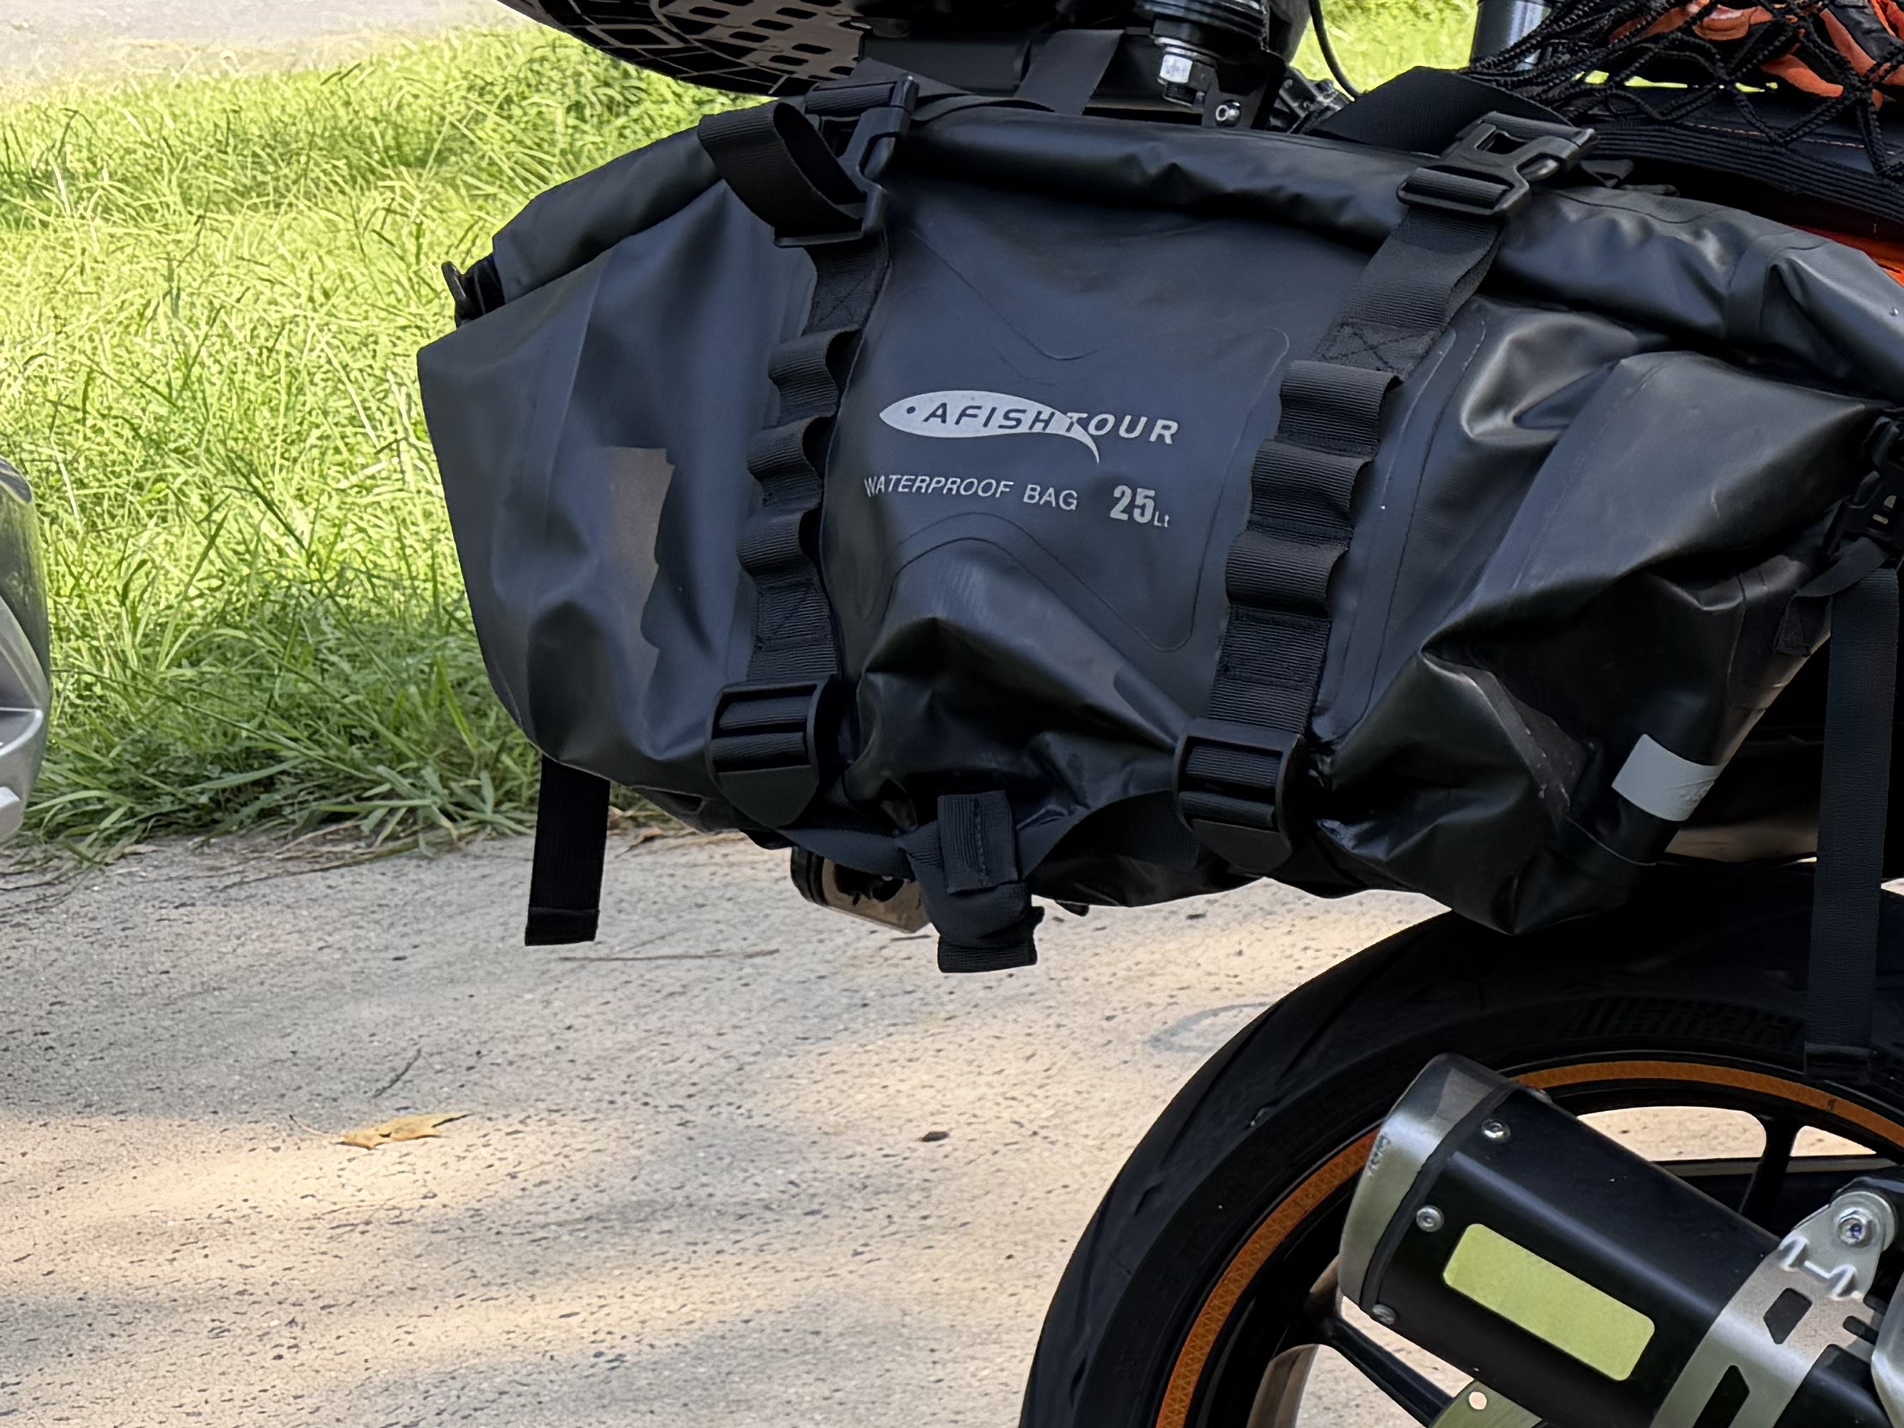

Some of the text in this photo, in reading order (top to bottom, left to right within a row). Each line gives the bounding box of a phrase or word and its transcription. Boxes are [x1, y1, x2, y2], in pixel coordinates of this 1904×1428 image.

[921, 401, 1180, 445] AFISHTOUR
[863, 474, 1016, 499] WATERPROOF
[1022, 484, 1079, 511] BAG
